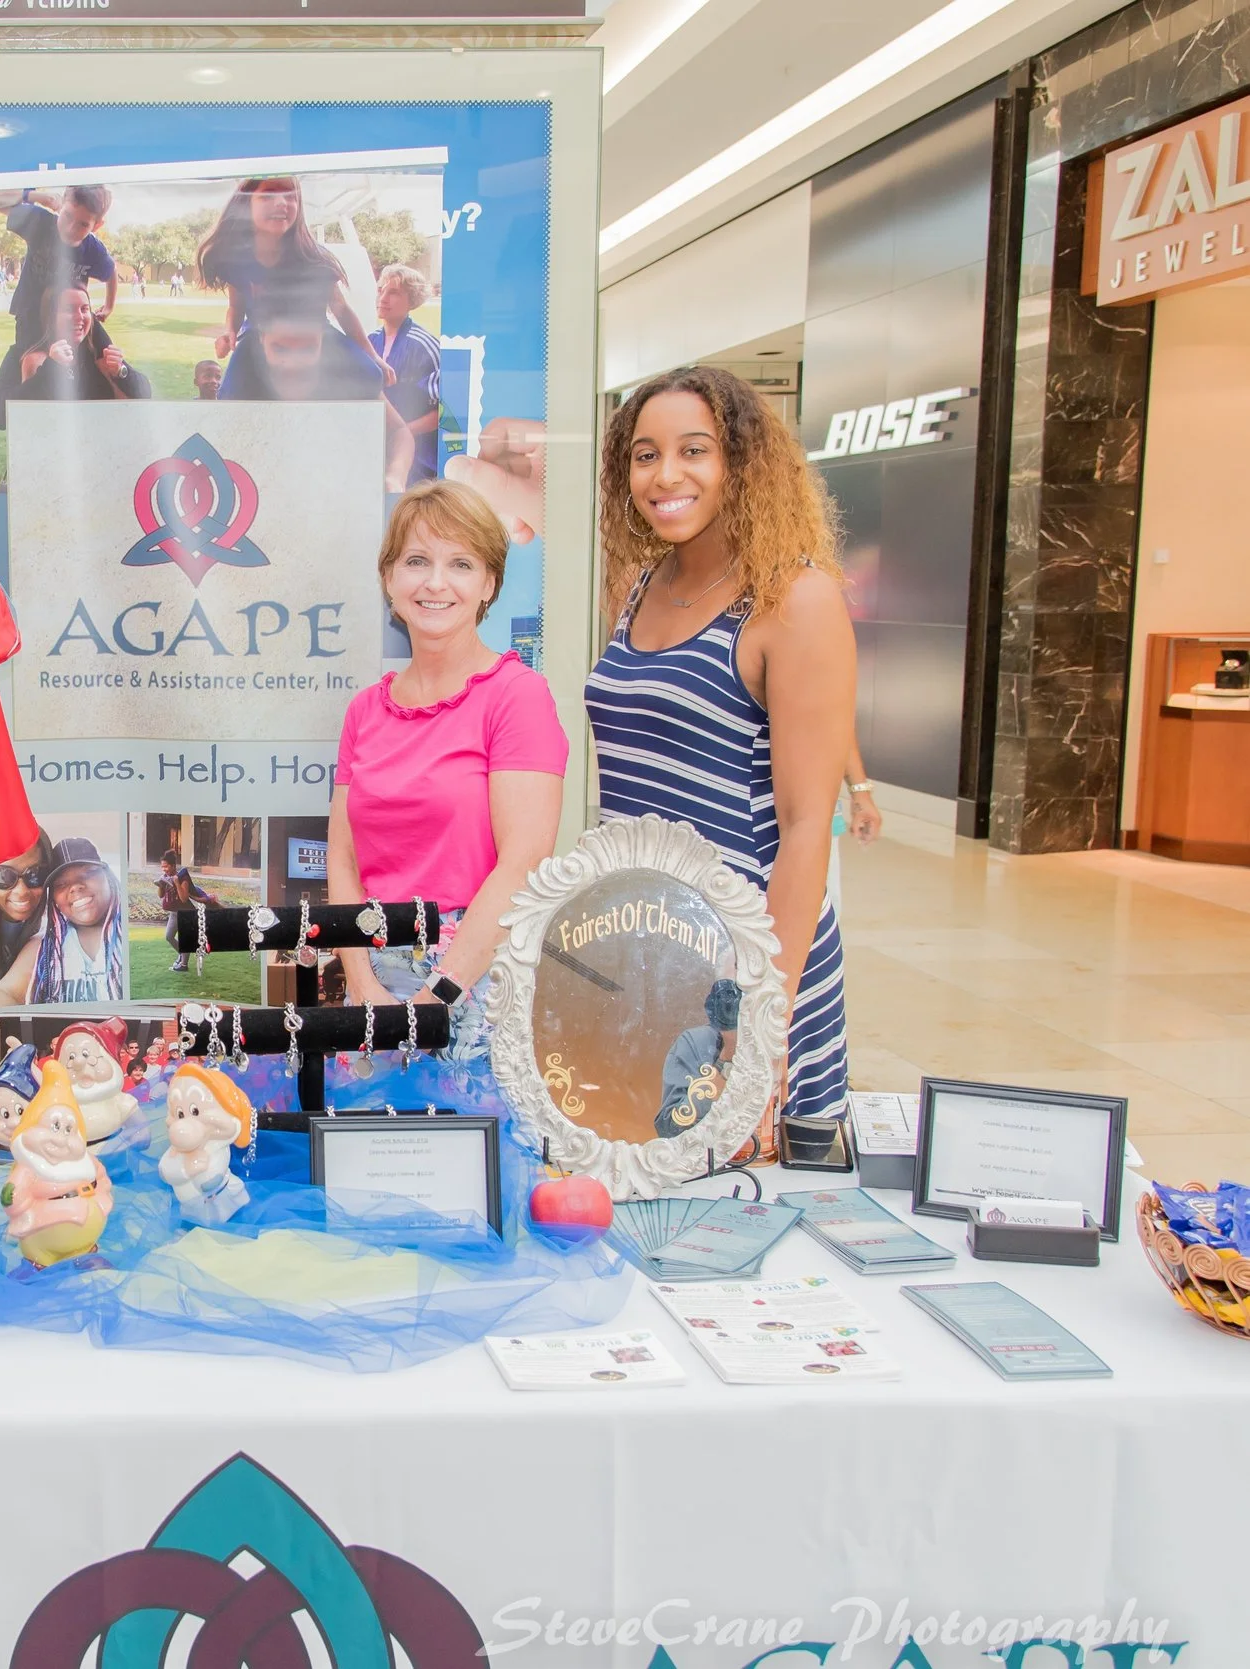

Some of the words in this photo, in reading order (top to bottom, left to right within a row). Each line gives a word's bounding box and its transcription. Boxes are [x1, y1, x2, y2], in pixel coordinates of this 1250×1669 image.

[806, 386, 970, 462] BOSE
[46, 597, 348, 659] AGAPE
[39, 670, 124, 690] Resource
[130, 670, 142, 689] &
[148, 670, 246, 691] Assistance
[252, 671, 320, 693] Center,
[326, 671, 360, 691] Inc.
[17, 753, 146, 784] Homes.
[158, 743, 256, 803] Help.
[559, 906, 621, 953] Fairest
[621, 899, 644, 933] Of
[645, 894, 693, 948] Them
[693, 925, 719, 965] All
[1008, 1216, 1051, 1225] AGAPE
[753, 1283, 801, 1293] 9.20.18
[783, 1332, 831, 1342] 9.20.18
